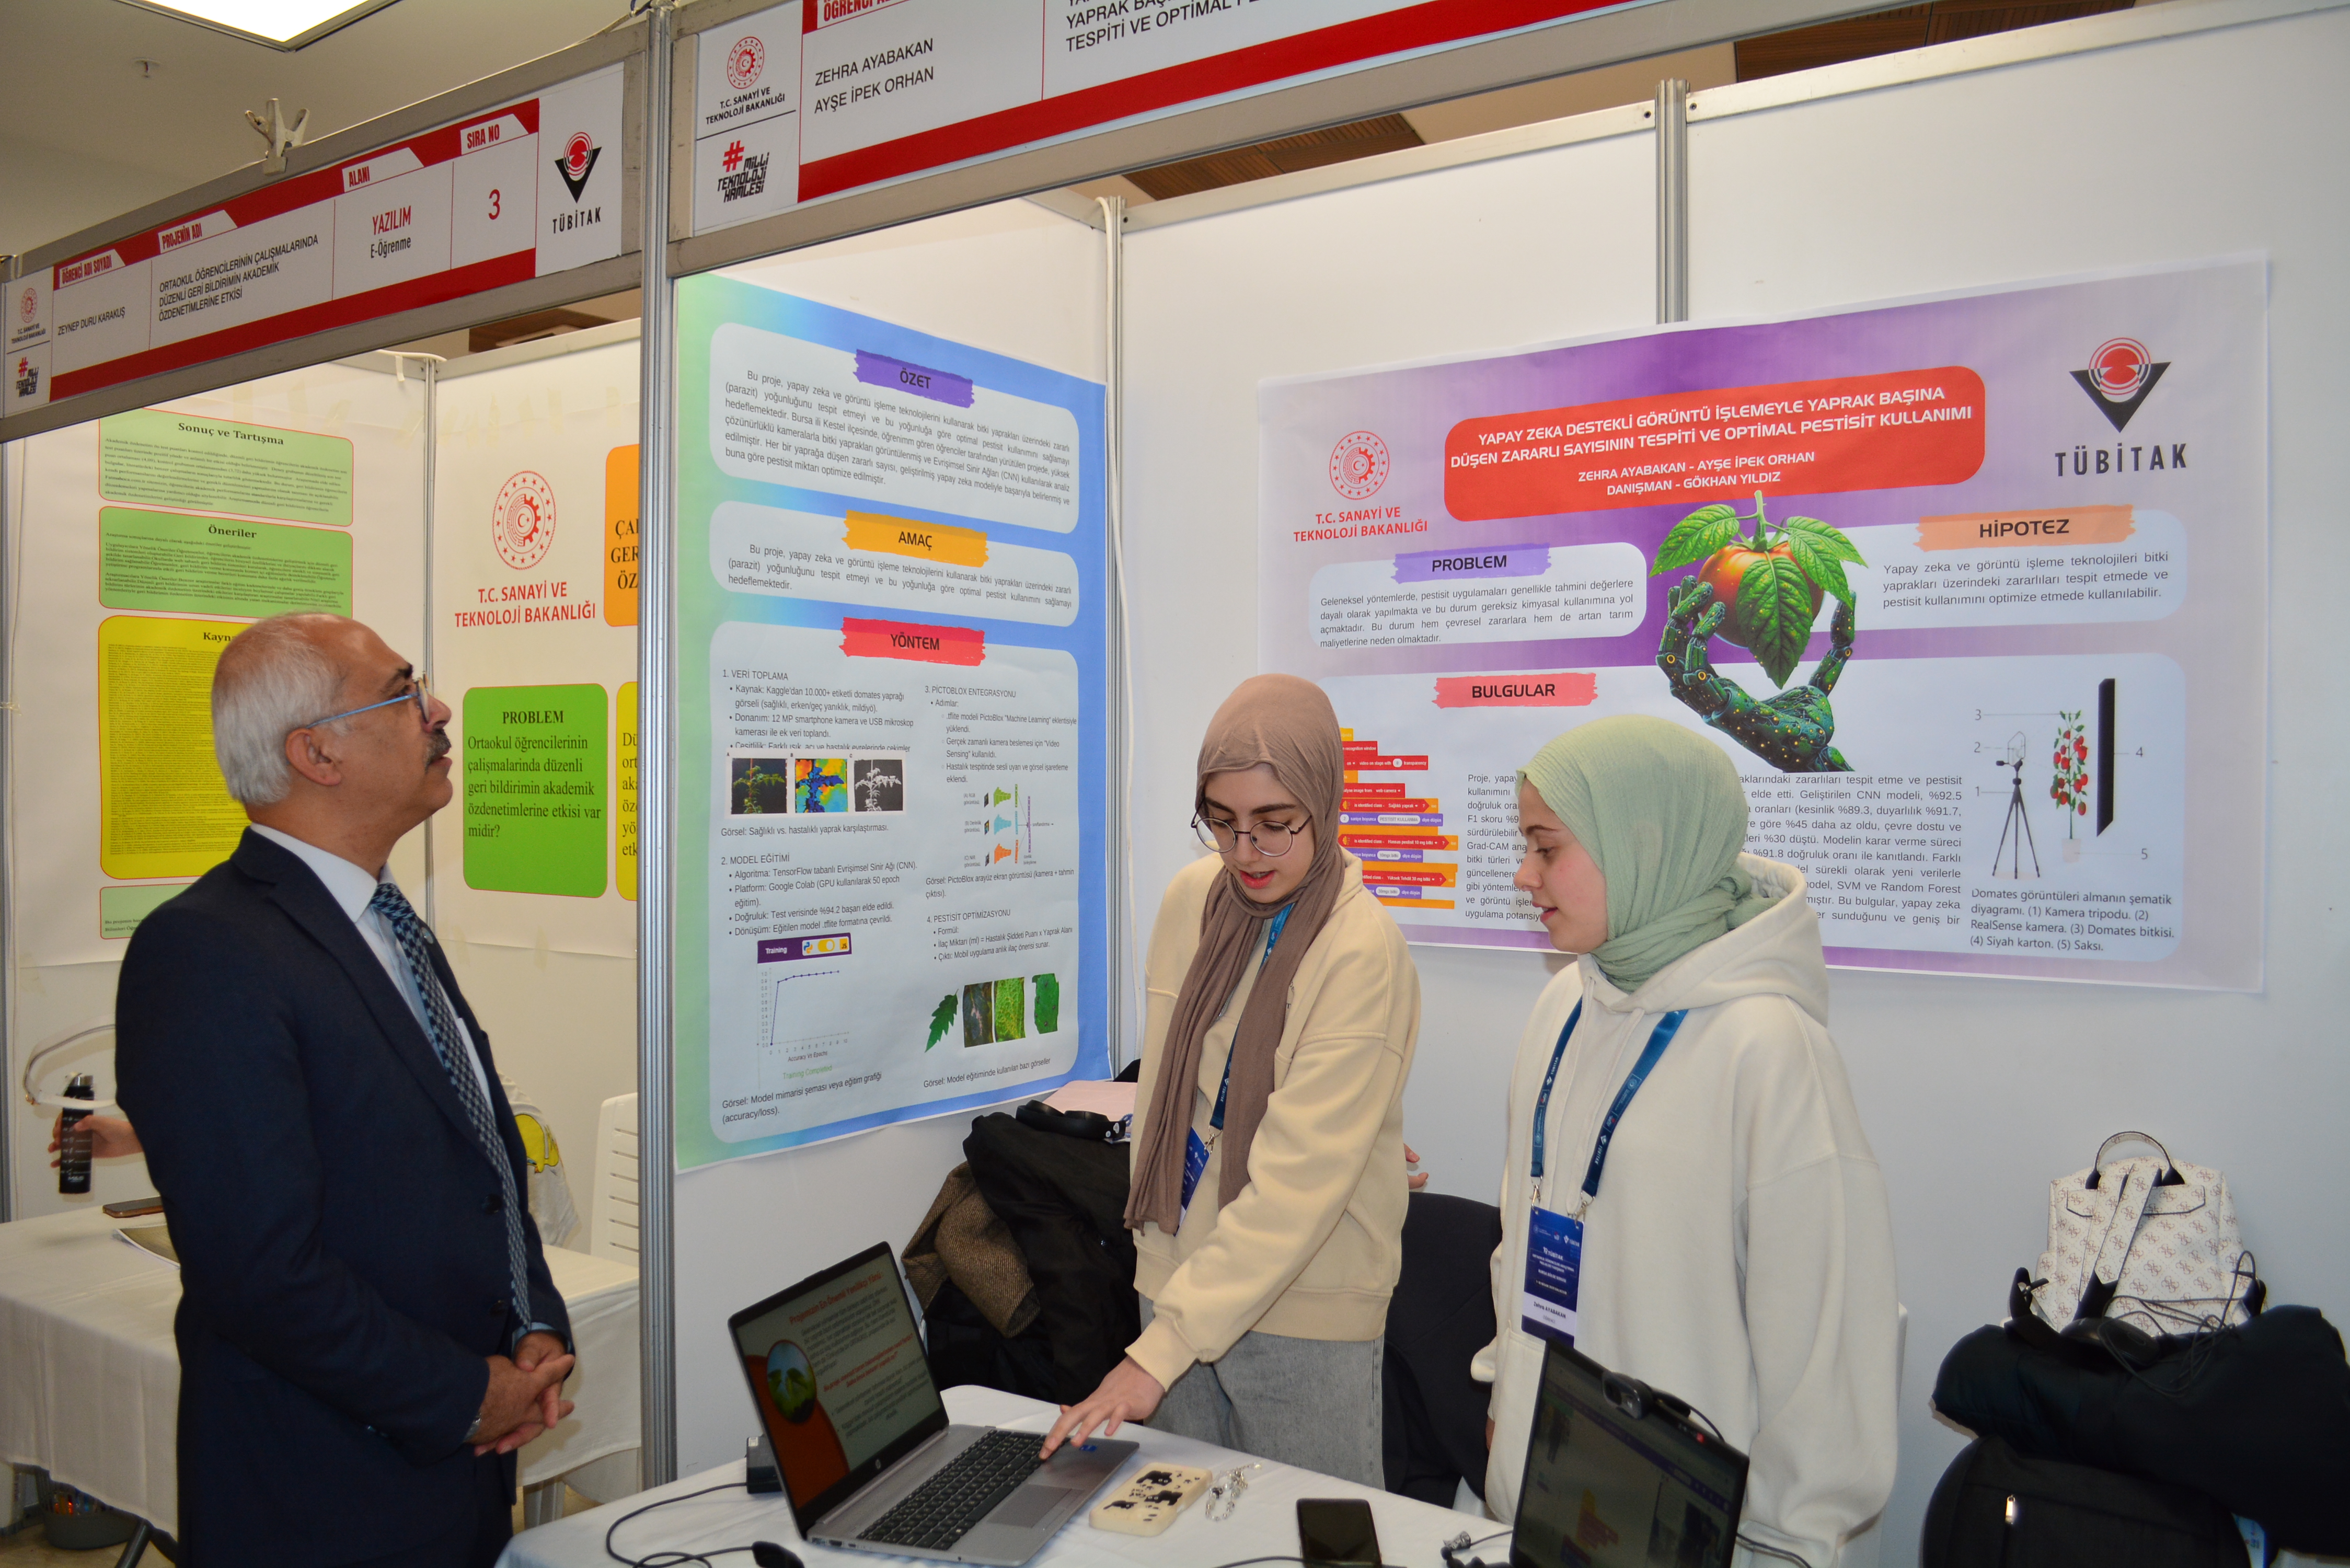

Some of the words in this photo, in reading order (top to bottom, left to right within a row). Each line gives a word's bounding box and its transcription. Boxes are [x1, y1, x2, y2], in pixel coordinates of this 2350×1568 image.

[1067, 0, 1128, 30] YAPRAK
[1066, 20, 1124, 52] TESPİTİ
[1130, 15, 1150, 34] VE
[815, 61, 858, 86] ZEHRA
[862, 38, 932, 72] AYABAKAN
[720, 99, 731, 109] T.C.
[734, 88, 759, 105] SANAYİ
[761, 87, 770, 96] VE
[815, 91, 847, 113] AYŞE
[851, 82, 880, 103] İPEK
[885, 66, 933, 93] ORHAN
[706, 105, 743, 125] TEKNOLOJİ
[746, 93, 785, 112] BAKANLIĞI
[467, 125, 487, 149] SIRA
[487, 123, 501, 144] NO
[349, 166, 370, 188] ALANI
[718, 167, 767, 191] TEKNOLOJİ
[723, 180, 764, 203] HAMLESİ
[489, 189, 500, 220] 3
[373, 205, 411, 235] YAZILIM
[553, 207, 601, 234] TÜBİTAK
[162, 226, 191, 249] PROJENİN
[192, 223, 202, 238] ADI
[371, 236, 412, 259] E-Öğrenme
[62, 262, 83, 284] ÖĞRENCİ
[94, 255, 112, 274] SOYADI
[160, 274, 193, 293] ORTAOKUL
[195, 253, 252, 282] ÖĞRENCİLERİNİN
[255, 234, 318, 266] ÇALIŞMALARINDA
[159, 288, 186, 307] DÜZENLİ
[188, 282, 203, 298] GERİ
[205, 272, 240, 294] BİLDİRİMİN
[243, 261, 279, 282] AKADEMİK
[159, 294, 219, 321] ÖZDENETİMLERİNE
[221, 285, 242, 304] ETKİSİ
[58, 321, 79, 336] ZEYNEP
[81, 315, 97, 329] DURU
[98, 307, 125, 324] KARAKUŞ
[900, 367, 931, 389] ÖZET
[1479, 430, 1523, 445] YAPAY
[1527, 426, 1562, 440] ZEKA
[1567, 414, 1632, 435] DESTEKLİ
[1637, 406, 1710, 427] GÖRÜNTÜ
[1716, 400, 1802, 422] İŞLEMEYLE
[1808, 394, 1874, 411] YAPRAK
[1880, 387, 1944, 406] BAŞINA
[179, 423, 214, 436] Sonuç
[233, 431, 283, 445] Tartışma
[1452, 452, 1497, 468] DÜŞEN
[1502, 445, 1559, 462] ZARARLI
[1564, 437, 1633, 456] SAYISININ
[1638, 428, 1695, 447] TESPİTİ
[1700, 429, 1720, 442] VE
[1725, 422, 1796, 440] OPTİMAL
[1801, 413, 1875, 433] PESTİSİT
[1881, 407, 1971, 426] KULLANIMI
[1579, 469, 1618, 482] ZEHRA
[1621, 462, 1685, 478] AYABAKAN
[1697, 458, 1731, 471] AYŞE
[1735, 456, 1764, 468] İPEK
[1768, 452, 1814, 465] ORHAN
[2055, 443, 2186, 476] TÜBİTAK
[1608, 480, 1672, 495] DANIŞMAN
[1684, 475, 1736, 488] GÖKHAN
[1741, 471, 1780, 484] YILDIZ
[1316, 513, 1335, 524] T.C.
[1339, 506, 1381, 522] SANAYİ
[1385, 506, 1400, 518] VE
[209, 525, 257, 538] Öneriler
[1294, 524, 1356, 542] TEKNOLOJİ
[1362, 518, 1427, 537] BAKANLIĞI
[1980, 519, 2069, 537] HİPOTEZ
[898, 532, 932, 550] AMAÇ
[1432, 555, 1506, 572] PROBLEM
[1884, 565, 1918, 575] Yapay
[1925, 562, 1951, 572] zeka
[1977, 559, 2019, 572] görüntü
[2027, 558, 2064, 570] işleme
[2071, 552, 2137, 566] teknolojileri
[2145, 551, 2168, 562] bitki
[478, 587, 498, 603] T.C.
[502, 580, 546, 602] SANAYİ
[551, 581, 567, 598] VE
[1321, 595, 1363, 606] Geleneksel
[1367, 593, 1417, 605] yöntemlerde,
[1422, 590, 1449, 602] pestisit
[1453, 587, 1506, 599] uygulamaları
[1511, 584, 1551, 597] genellikle
[1556, 581, 1586, 592] tahmini
[1591, 579, 1633, 591] değerlere
[1883, 580, 1936, 593] yaprakları
[1943, 577, 1999, 588] üzerindeki
[2006, 575, 2059, 585] zararlıları
[2066, 572, 2097, 585] tespit
[2104, 571, 2147, 582] etmede
[1884, 596, 1921, 609] pestisit
[1925, 595, 1984, 606] kullanımını
[1989, 592, 2036, 605] optimize
[2041, 591, 2084, 602] etmede
[2089, 587, 2161, 599] kullanılabilir.
[455, 605, 520, 627] TEKNOLOJİ
[525, 600, 595, 623] BAKANLIĞI
[891, 632, 939, 650] YÖNTEM
[731, 669, 749, 678] VERİ
[752, 671, 788, 680] TOPLAMA
[932, 685, 966, 695] PİCTOBLOX
[969, 688, 1016, 698] ENTEGRASYONU
[1472, 684, 1555, 698] BULGULAR
[503, 711, 563, 723] PROBLEM
[468, 735, 511, 749] Ortaokul
[515, 735, 588, 753] öğrencilerinin
[468, 758, 540, 774] çalişmalarinda
[544, 758, 582, 772] düzenli
[468, 780, 487, 797] geri
[490, 780, 539, 794] bildirimin
[544, 781, 594, 795] akademik
[468, 802, 548, 817] özdenetimlerine
[552, 804, 580, 818] etkisi
[584, 809, 601, 818] var
[468, 823, 500, 837] midir?
[721, 857, 728, 865] 2.
[730, 856, 758, 864] MODEL
[761, 852, 789, 863] EĞİTİMİ
[1972, 889, 2017, 899] Domates
[2021, 890, 2079, 902] görüntüleri
[2083, 892, 2125, 903] almanın
[2129, 894, 2171, 905] şematik
[934, 913, 961, 923] PESTİSİT
[963, 909, 1010, 920] OPTİMİZASYONU
